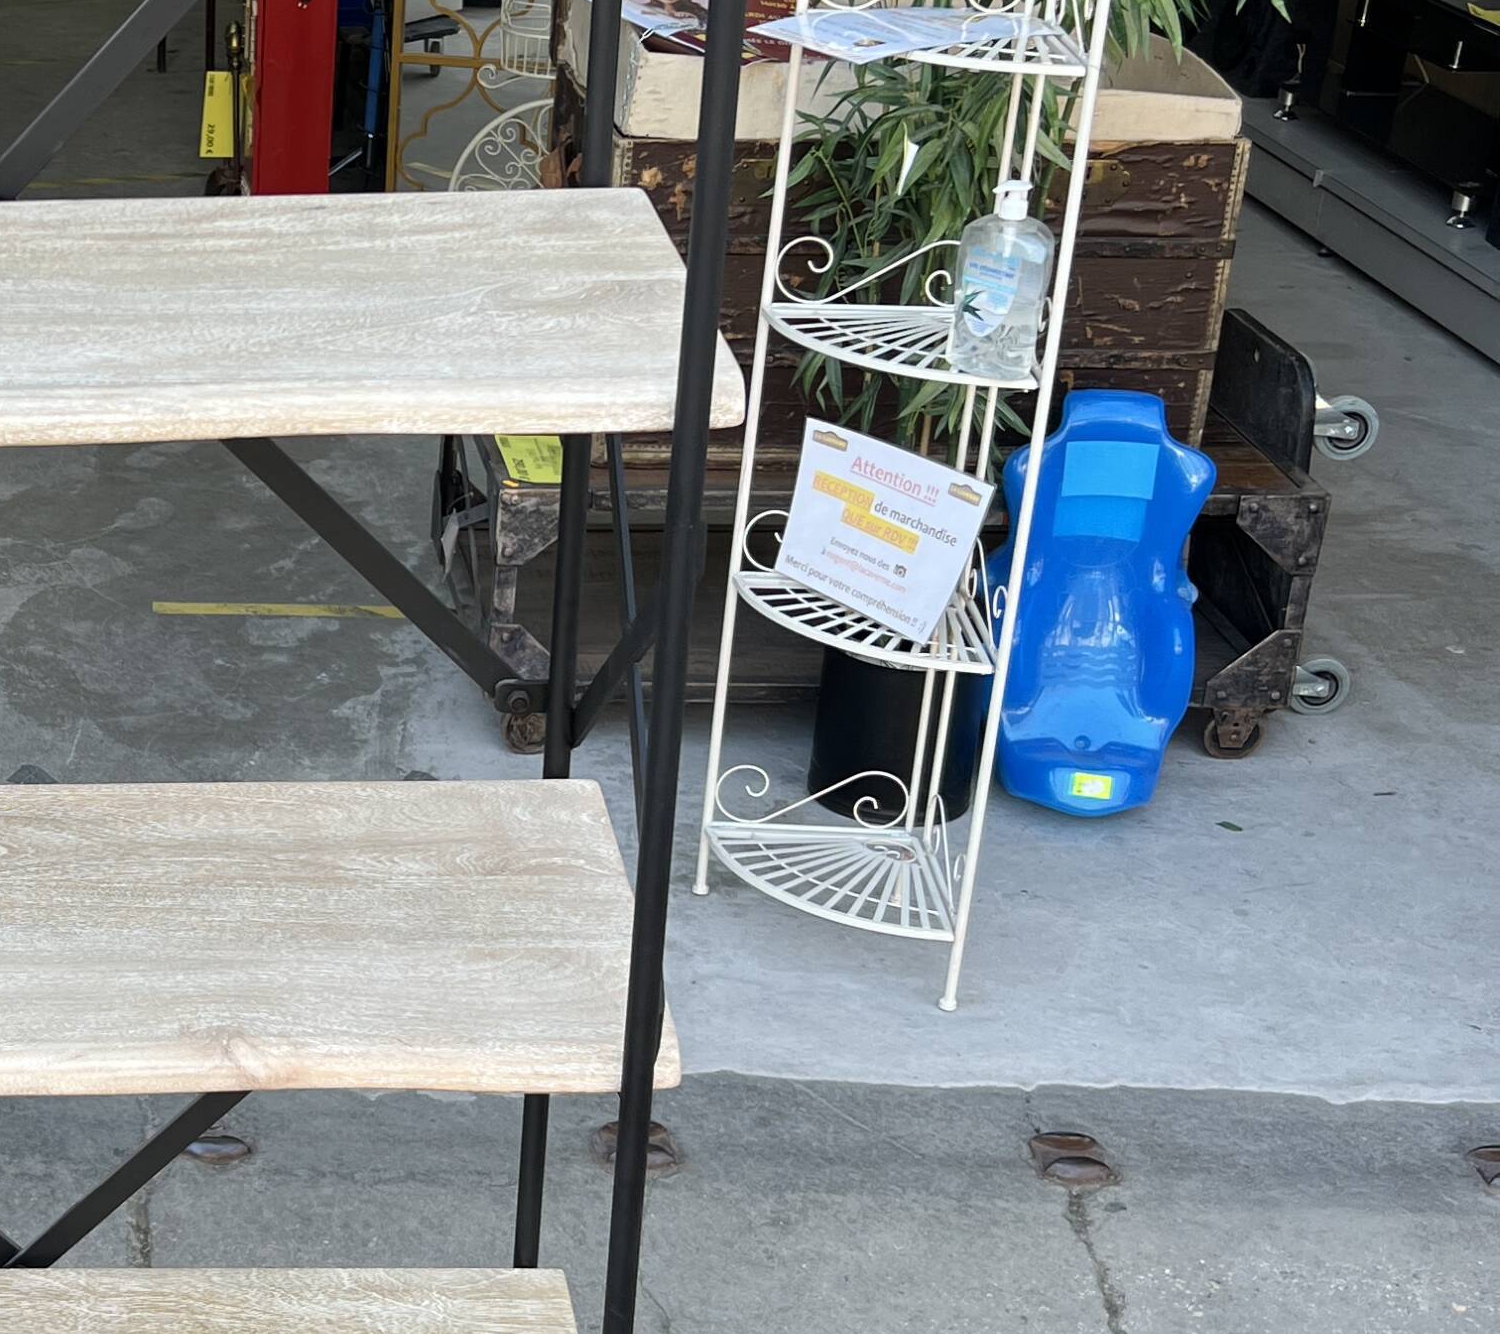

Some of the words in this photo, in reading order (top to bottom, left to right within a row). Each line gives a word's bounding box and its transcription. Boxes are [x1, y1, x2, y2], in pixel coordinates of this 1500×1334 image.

[852, 456, 922, 497] Attention
[874, 500, 889, 517] de
[890, 511, 957, 547] marchandise
[883, 526, 906, 546] RDV
[785, 554, 808, 572] Merci
[808, 566, 829, 582] pour
[829, 576, 850, 594] votre
[852, 585, 911, 624] compréhension
